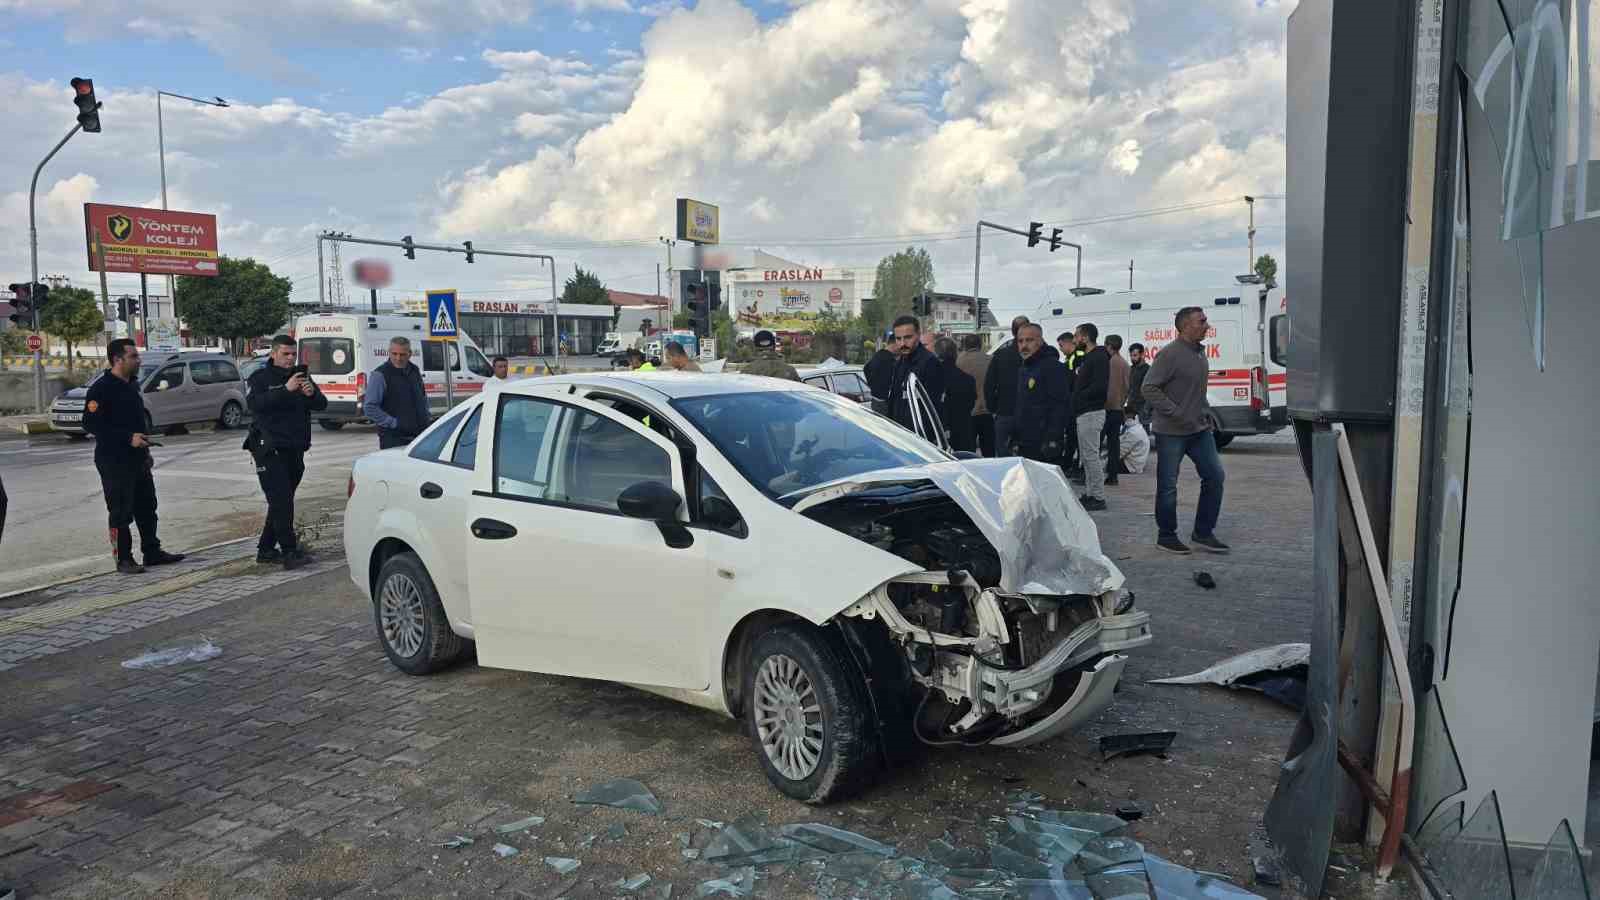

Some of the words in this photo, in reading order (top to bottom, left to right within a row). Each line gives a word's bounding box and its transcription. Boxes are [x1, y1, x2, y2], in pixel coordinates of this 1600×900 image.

[138, 220, 204, 235] YÖNTEM
[762, 269, 824, 282] ERASLAN
[473, 300, 519, 313] ERASLAN
[1144, 328, 1174, 342] SAĞLIK
